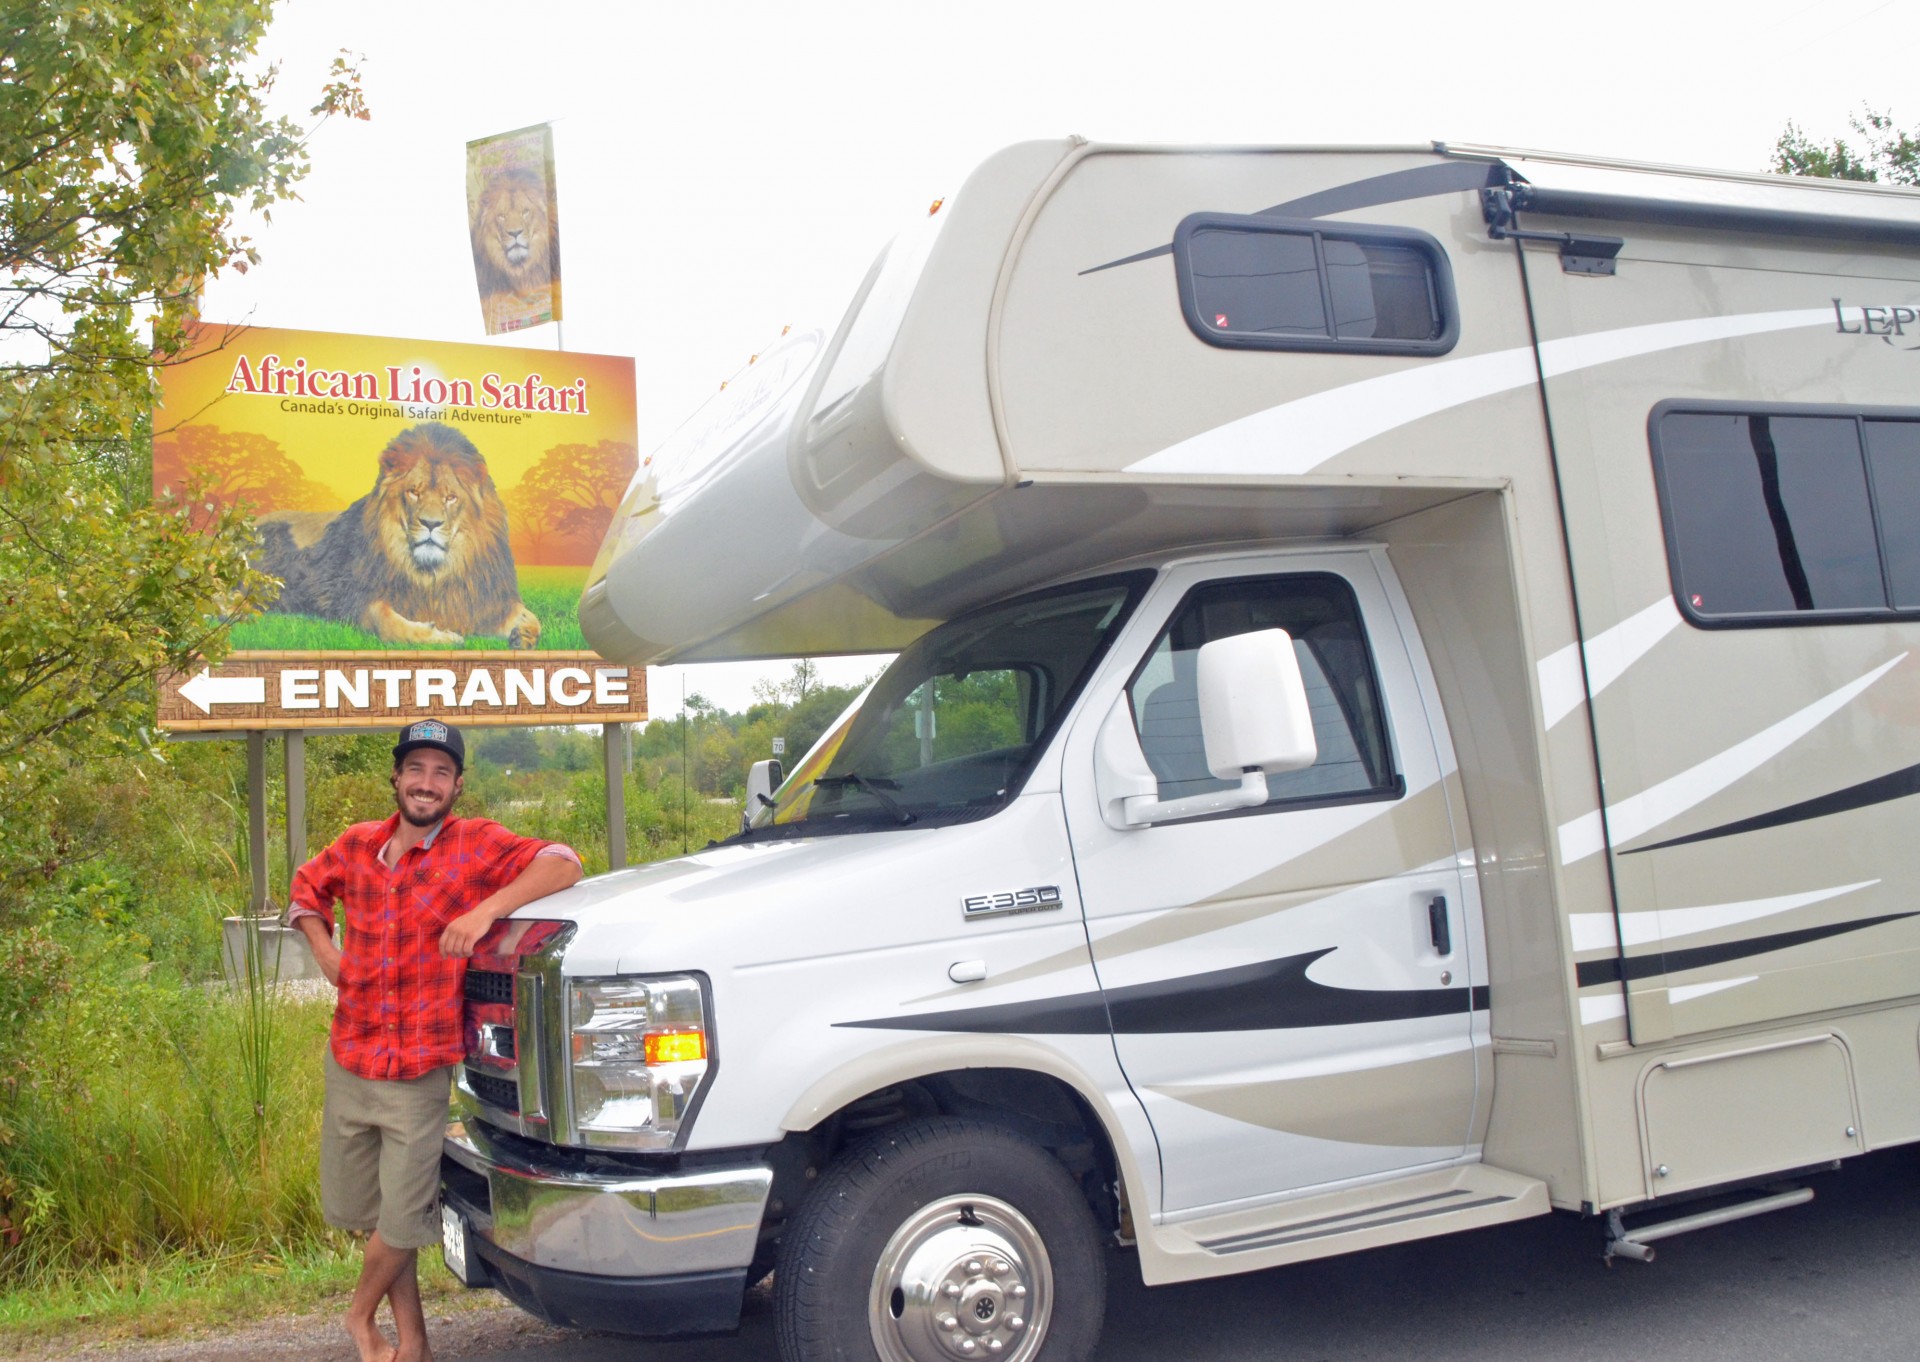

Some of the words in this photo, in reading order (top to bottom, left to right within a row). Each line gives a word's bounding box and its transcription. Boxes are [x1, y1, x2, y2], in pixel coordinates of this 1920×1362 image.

[1831, 297, 1920, 336] LEP
[226, 355, 380, 400] African
[386, 367, 475, 406] Lion
[481, 373, 589, 414] Safari
[280, 399, 344, 415] Canada's
[347, 403, 404, 419] Original
[408, 406, 448, 420] Safari
[281, 668, 629, 708] ENTRANCE
[774, 743, 783, 751] 70
[965, 886, 1060, 912] E-350
